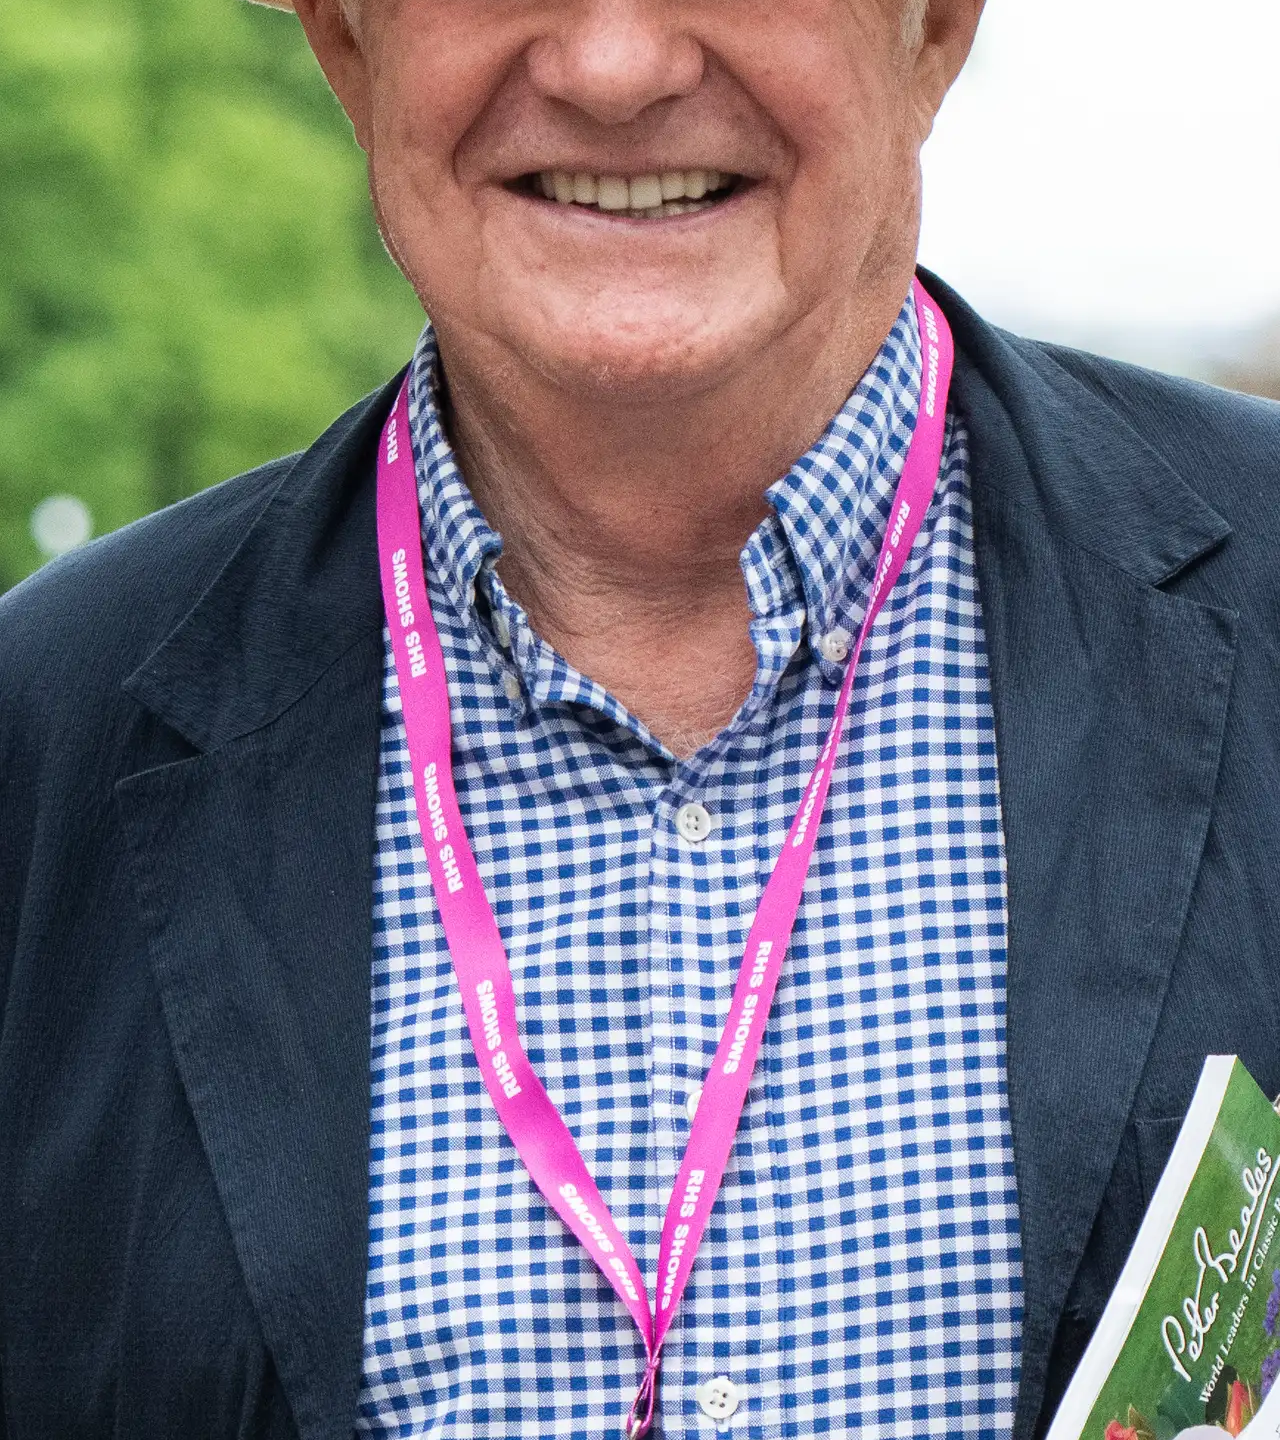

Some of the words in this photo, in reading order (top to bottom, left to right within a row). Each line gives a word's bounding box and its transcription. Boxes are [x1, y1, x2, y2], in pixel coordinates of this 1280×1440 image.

[922, 305, 939, 344] RHS
[925, 345, 939, 418] SHOWS
[387, 418, 398, 464] RHS
[890, 500, 911, 548] RHS
[392, 548, 415, 628] SHOWS
[405, 630, 427, 678] RHS
[424, 761, 448, 842] SHOWS
[792, 768, 824, 847] SHOWS
[439, 842, 464, 894] RHS
[750, 940, 773, 988] RHS
[476, 980, 501, 1050] SHOWS
[724, 994, 758, 1075] SHOWS
[492, 1051, 522, 1099] RHS
[559, 1183, 615, 1253] SHOWS
[680, 1169, 705, 1218] RHS
[609, 1257, 639, 1301] RHS
[662, 1224, 690, 1310] SHOWS
[1161, 1292, 1220, 1382] Peter
[1194, 1147, 1271, 1283] Beales
[1199, 1356, 1224, 1404] World
[1221, 1294, 1250, 1357] Leaders
[1245, 1273, 1257, 1292] in
[1253, 1213, 1280, 1271] Classic
